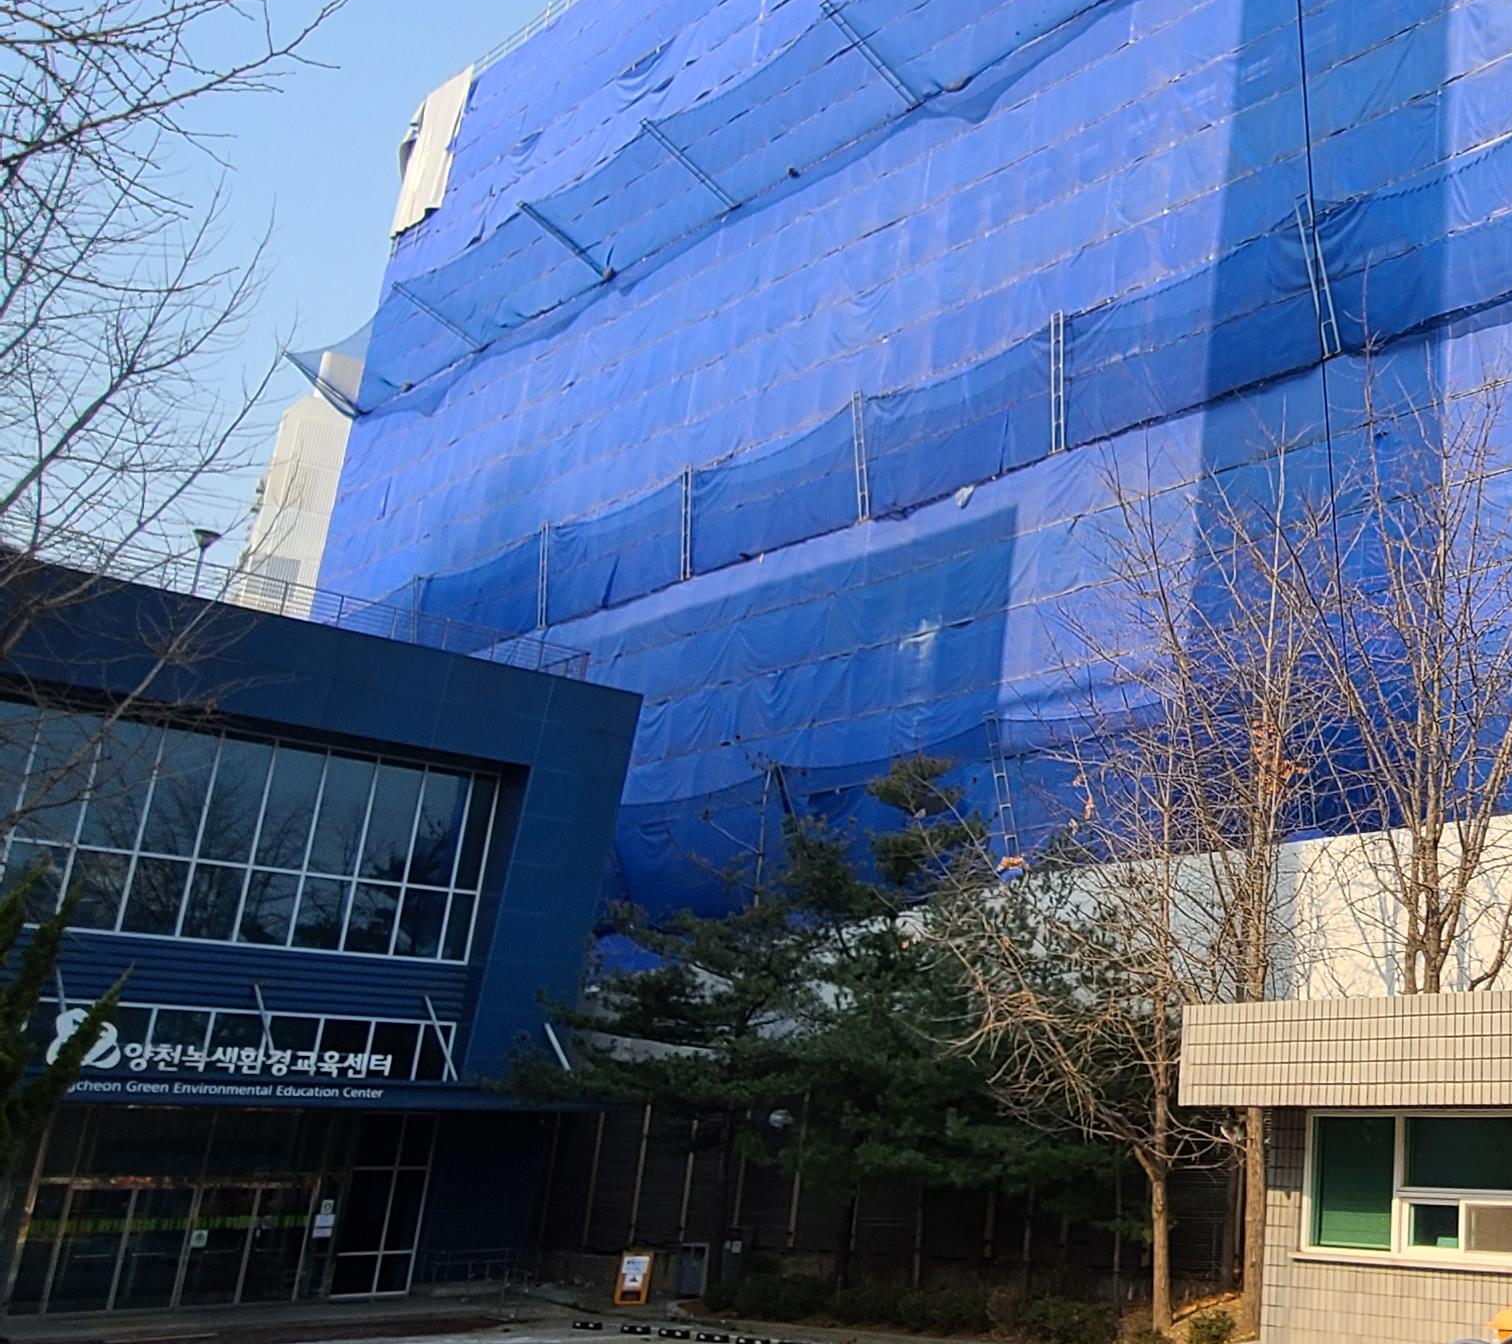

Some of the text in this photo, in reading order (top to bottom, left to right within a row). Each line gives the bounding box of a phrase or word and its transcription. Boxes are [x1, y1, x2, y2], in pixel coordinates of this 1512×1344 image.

[123, 1042, 393, 1079] 양천녹색환경교육센터
[126, 1081, 169, 1093] Green
[173, 1082, 272, 1096] Environmental
[276, 1085, 339, 1098] Education
[343, 1087, 384, 1099] Center
